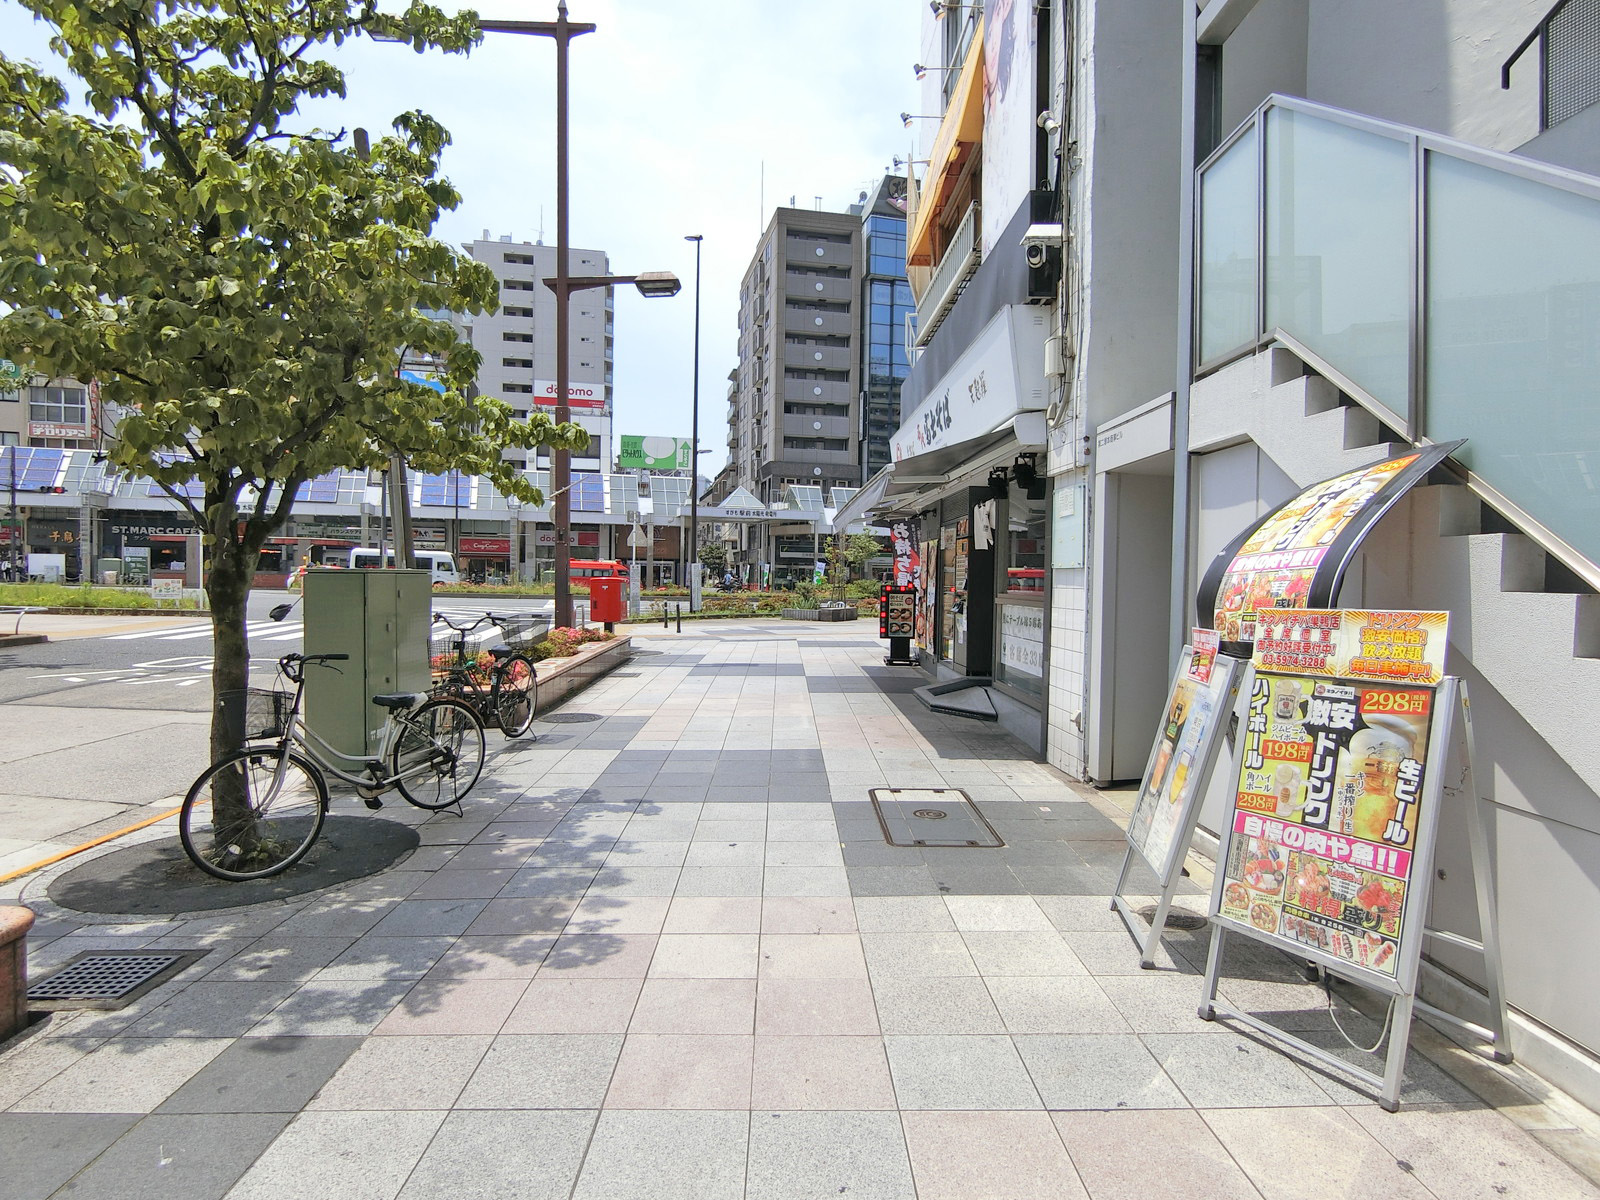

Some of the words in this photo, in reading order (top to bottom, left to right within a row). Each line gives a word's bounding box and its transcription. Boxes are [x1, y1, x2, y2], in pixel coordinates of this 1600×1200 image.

[546, 385, 593, 396] doomo
[49, 530, 80, 542] 千鳥
[111, 525, 164, 535] ST.MARC
[540, 534, 575, 543] doco
[1259, 615, 1340, 628] キタノイチバ巣鴨店
[1368, 612, 1423, 628] ドリンク
[1361, 628, 1427, 644] 激安価格!
[1362, 644, 1423, 660] 飲み放題
[1350, 659, 1432, 678] 毎日実施中!
[1304, 699, 1357, 730] 激安
[1244, 678, 1270, 769] ハイボール
[1271, 724, 1307, 735] ジムビーム
[1271, 733, 1306, 743] ハイボール
[1266, 742, 1308, 760] 198円
[1246, 771, 1272, 783] 角ハイ
[1305, 731, 1337, 824] ドリンク
[1356, 772, 1366, 797] キリン
[1245, 782, 1272, 793] ボール
[1239, 793, 1274, 811] 298円
[1383, 758, 1422, 844] 生ビール
[1243, 816, 1398, 874] 自慢の肉や魚!!
